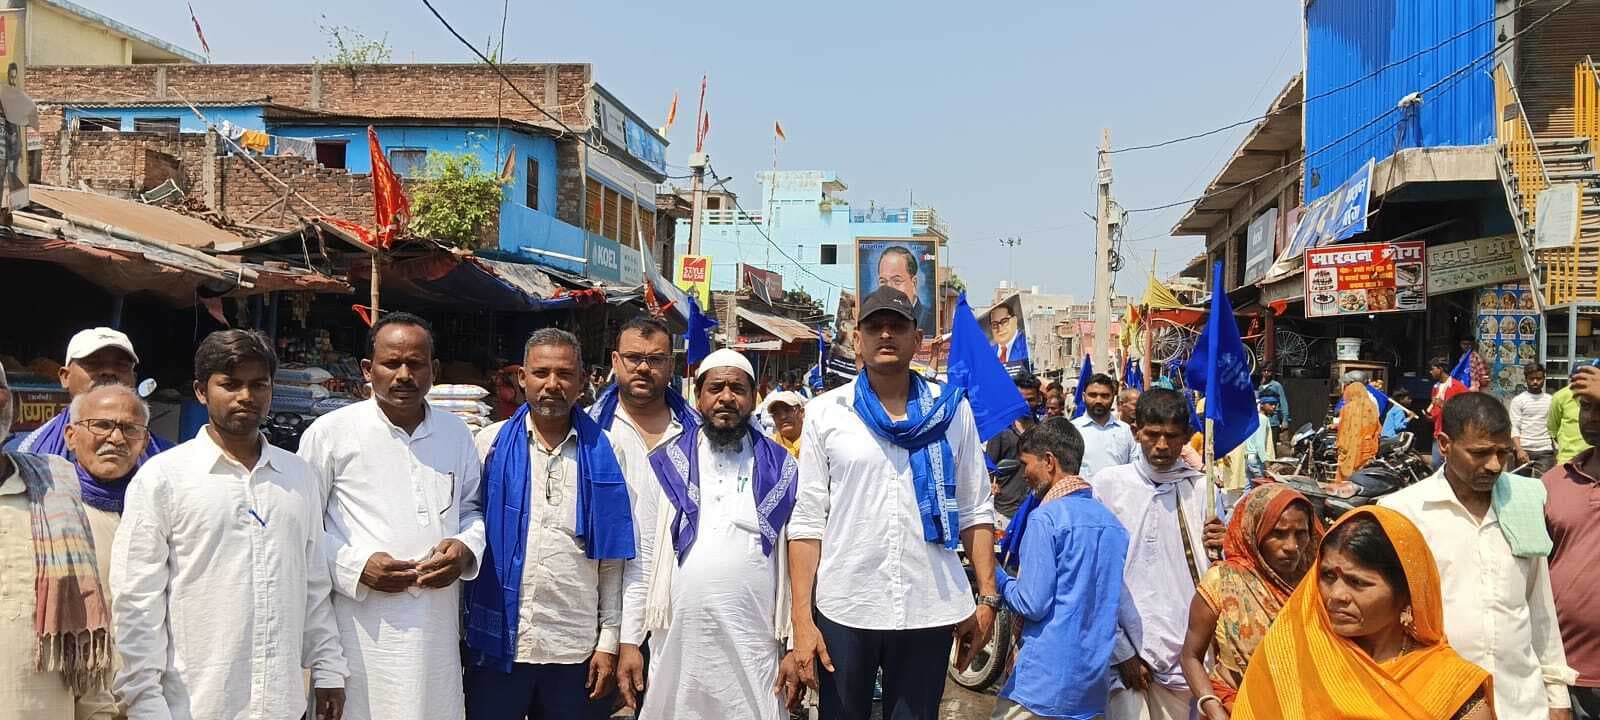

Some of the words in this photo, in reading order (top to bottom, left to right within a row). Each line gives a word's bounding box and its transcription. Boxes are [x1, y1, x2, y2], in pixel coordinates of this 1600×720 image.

[597, 244, 618, 270] KOEL
[1309, 249, 1374, 265] माखन
[684, 266, 704, 275] STYLE
